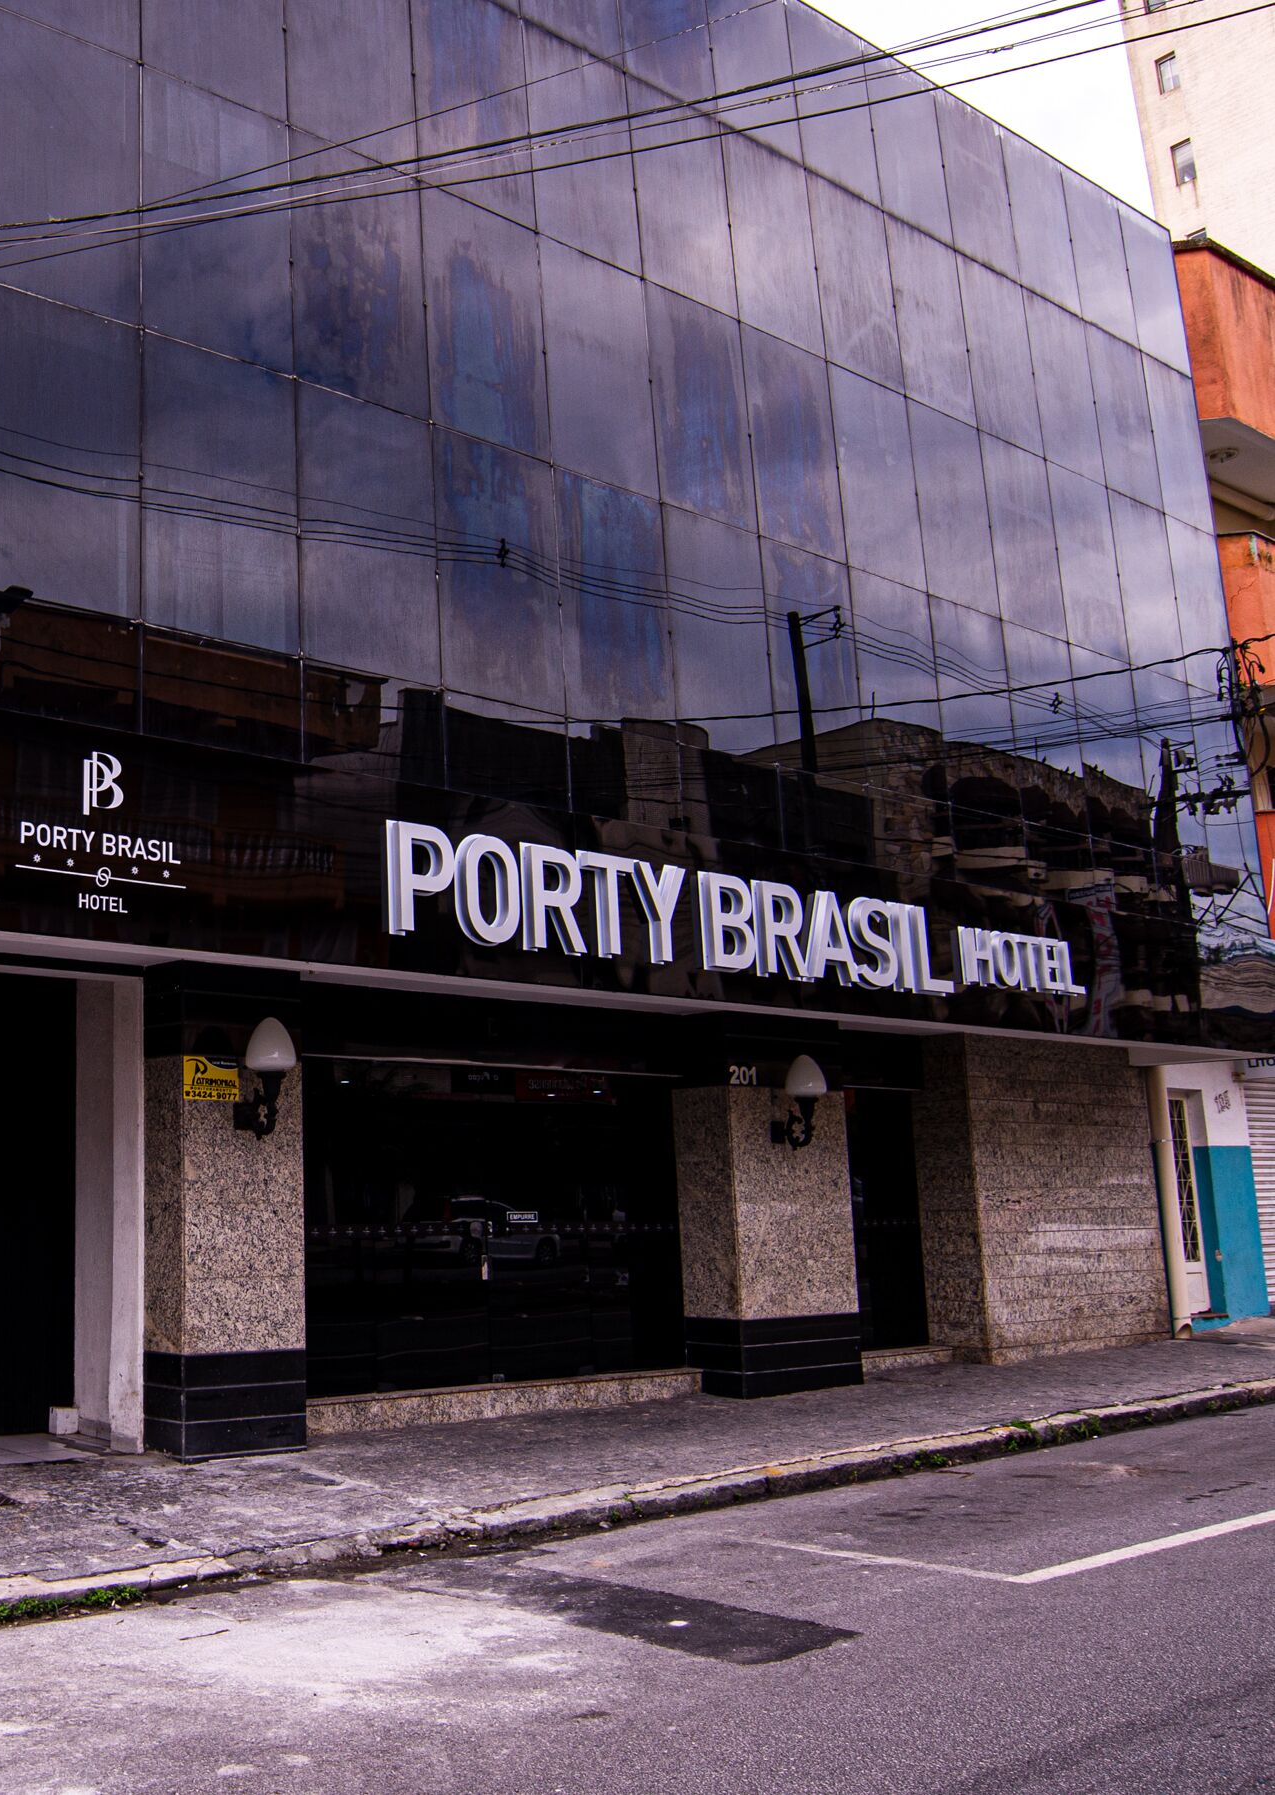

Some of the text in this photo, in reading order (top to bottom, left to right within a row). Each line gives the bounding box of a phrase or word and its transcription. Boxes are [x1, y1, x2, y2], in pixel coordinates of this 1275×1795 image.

[20, 821, 182, 866] PORTY BRASIL
[78, 892, 129, 914] HOTEL
[386, 819, 1087, 997] PORTY BRASIL HOTEL
[729, 1065, 757, 1085] 201
[191, 1090, 238, 1100] 3424-9077
